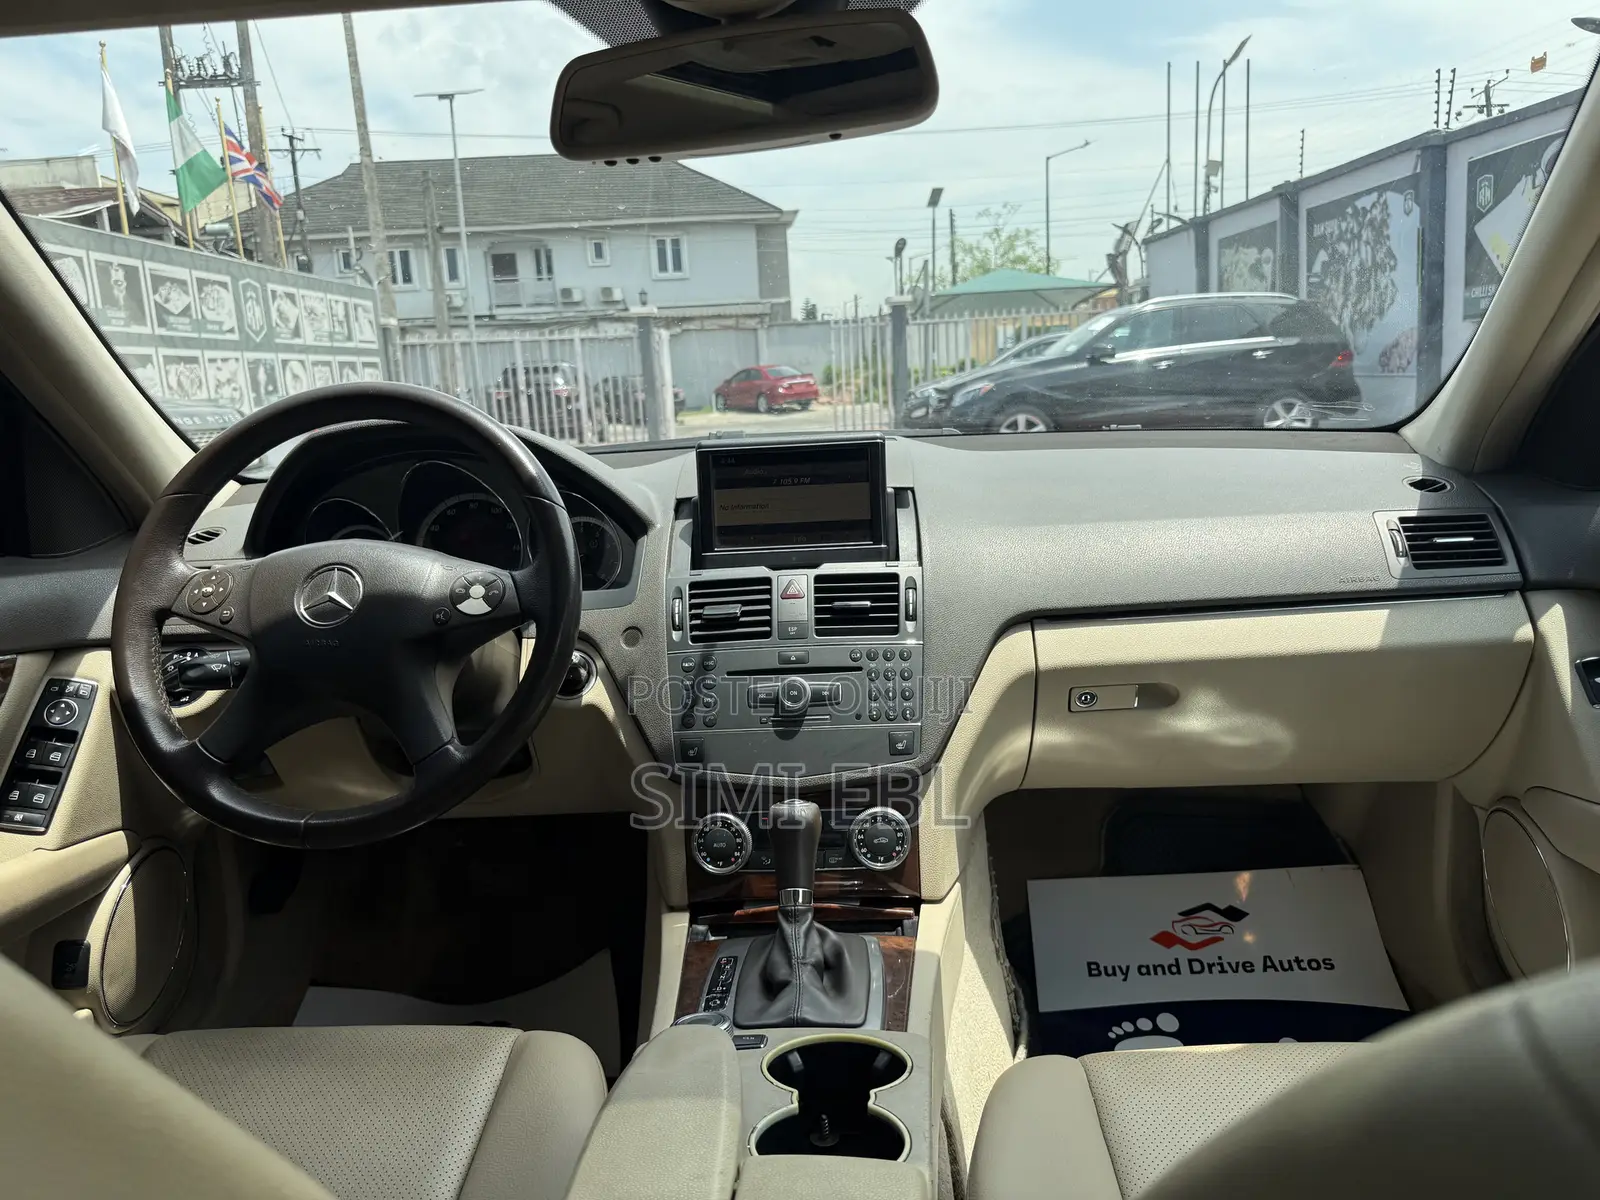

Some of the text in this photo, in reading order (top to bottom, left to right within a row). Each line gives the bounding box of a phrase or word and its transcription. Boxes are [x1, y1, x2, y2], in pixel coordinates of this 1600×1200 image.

[1086, 954, 1336, 982] Buy and Drive Autos
